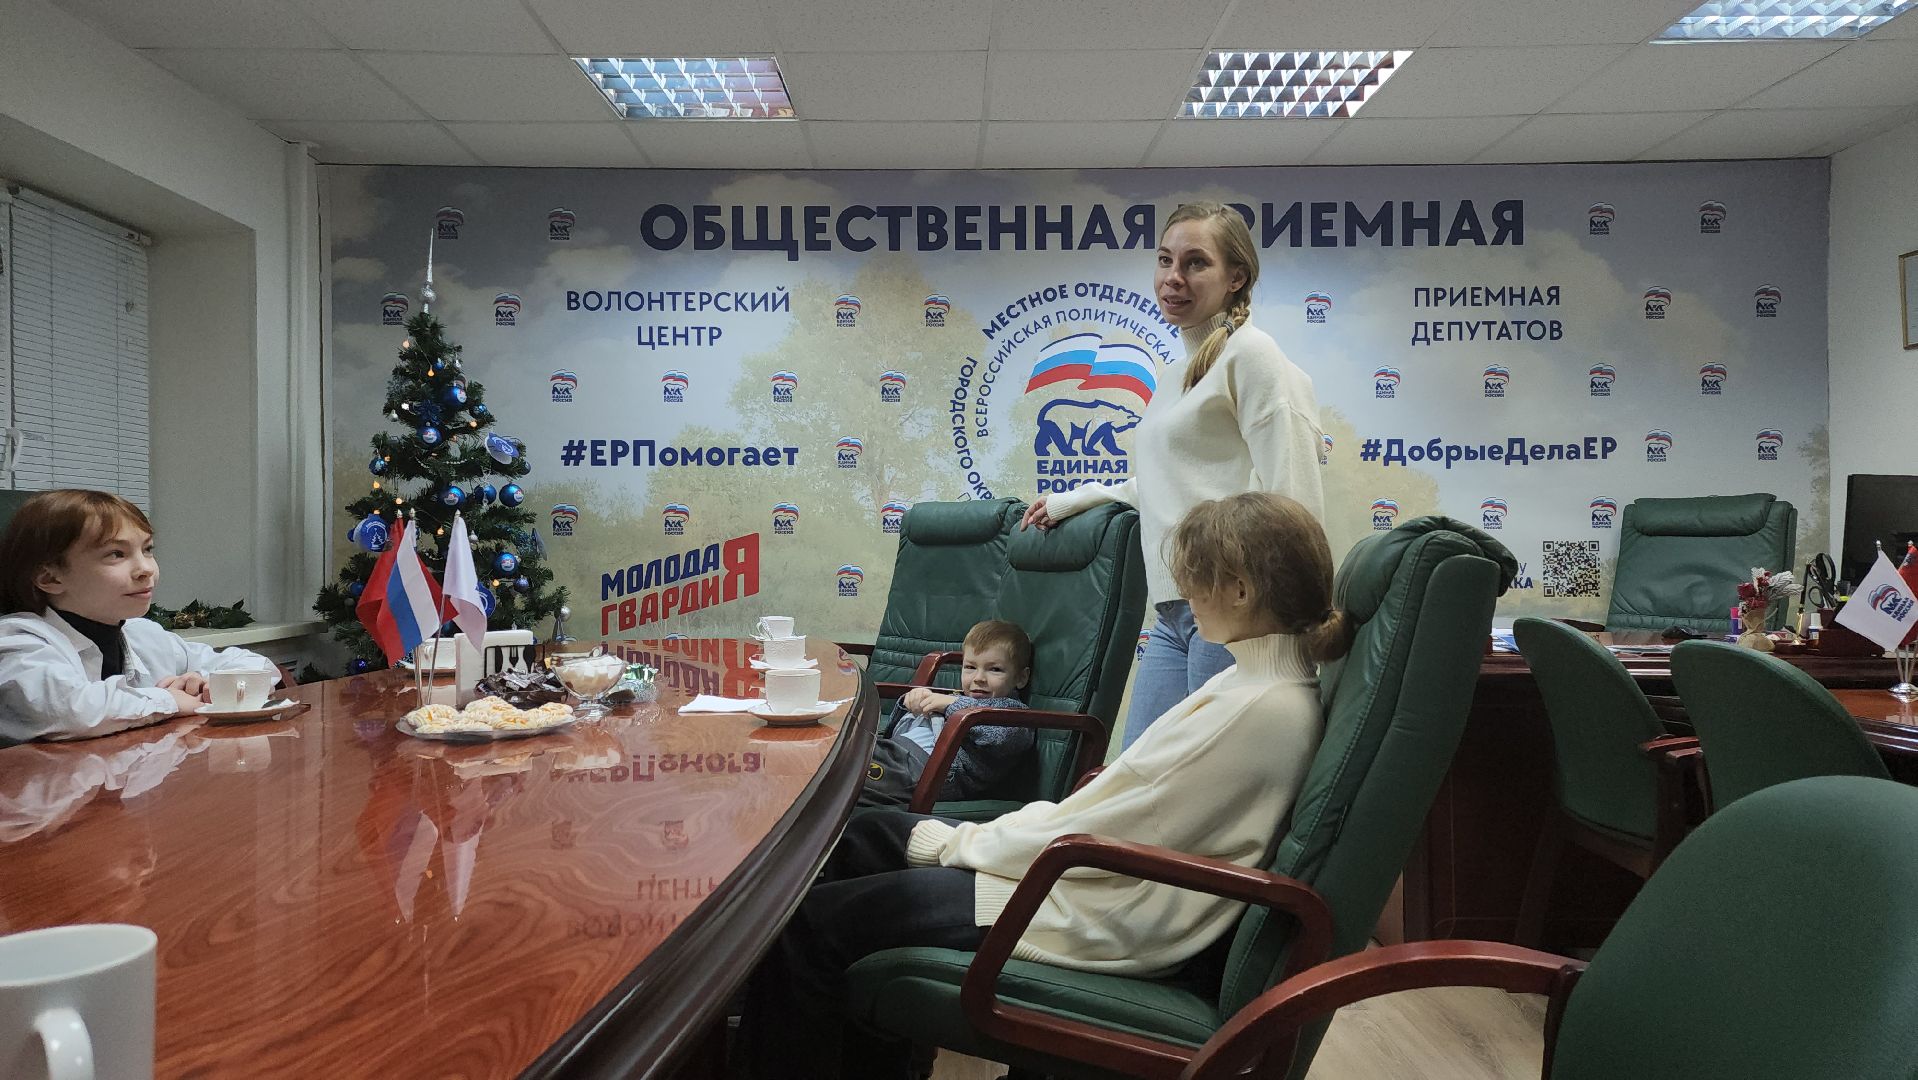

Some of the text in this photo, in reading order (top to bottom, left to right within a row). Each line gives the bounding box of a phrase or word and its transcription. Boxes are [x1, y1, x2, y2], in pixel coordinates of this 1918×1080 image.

[640, 200, 1524, 261] ОБЩЕСТВЕННАЯ ИЕМНАЯ
[566, 286, 790, 312] ВОЛОНТЕРСКИЙ
[1414, 286, 1560, 307] ПРИЕМНАЯ
[982, 284, 1068, 340] МЕСТНОЕ
[637, 326, 722, 350] ЦЕНТР
[1411, 320, 1563, 346] ДЕПУТАТОВ
[976, 315, 1052, 437] ВСЕРОССИЙСКАЯ
[950, 357, 978, 469] ГОРОДСКОГО
[968, 472, 995, 500] ОКР
[560, 439, 799, 467] #ЕРПомогает
[1360, 437, 1618, 469] #ДобрыеДелаЕР
[1037, 459, 1128, 476] ЕДИНАЯ
